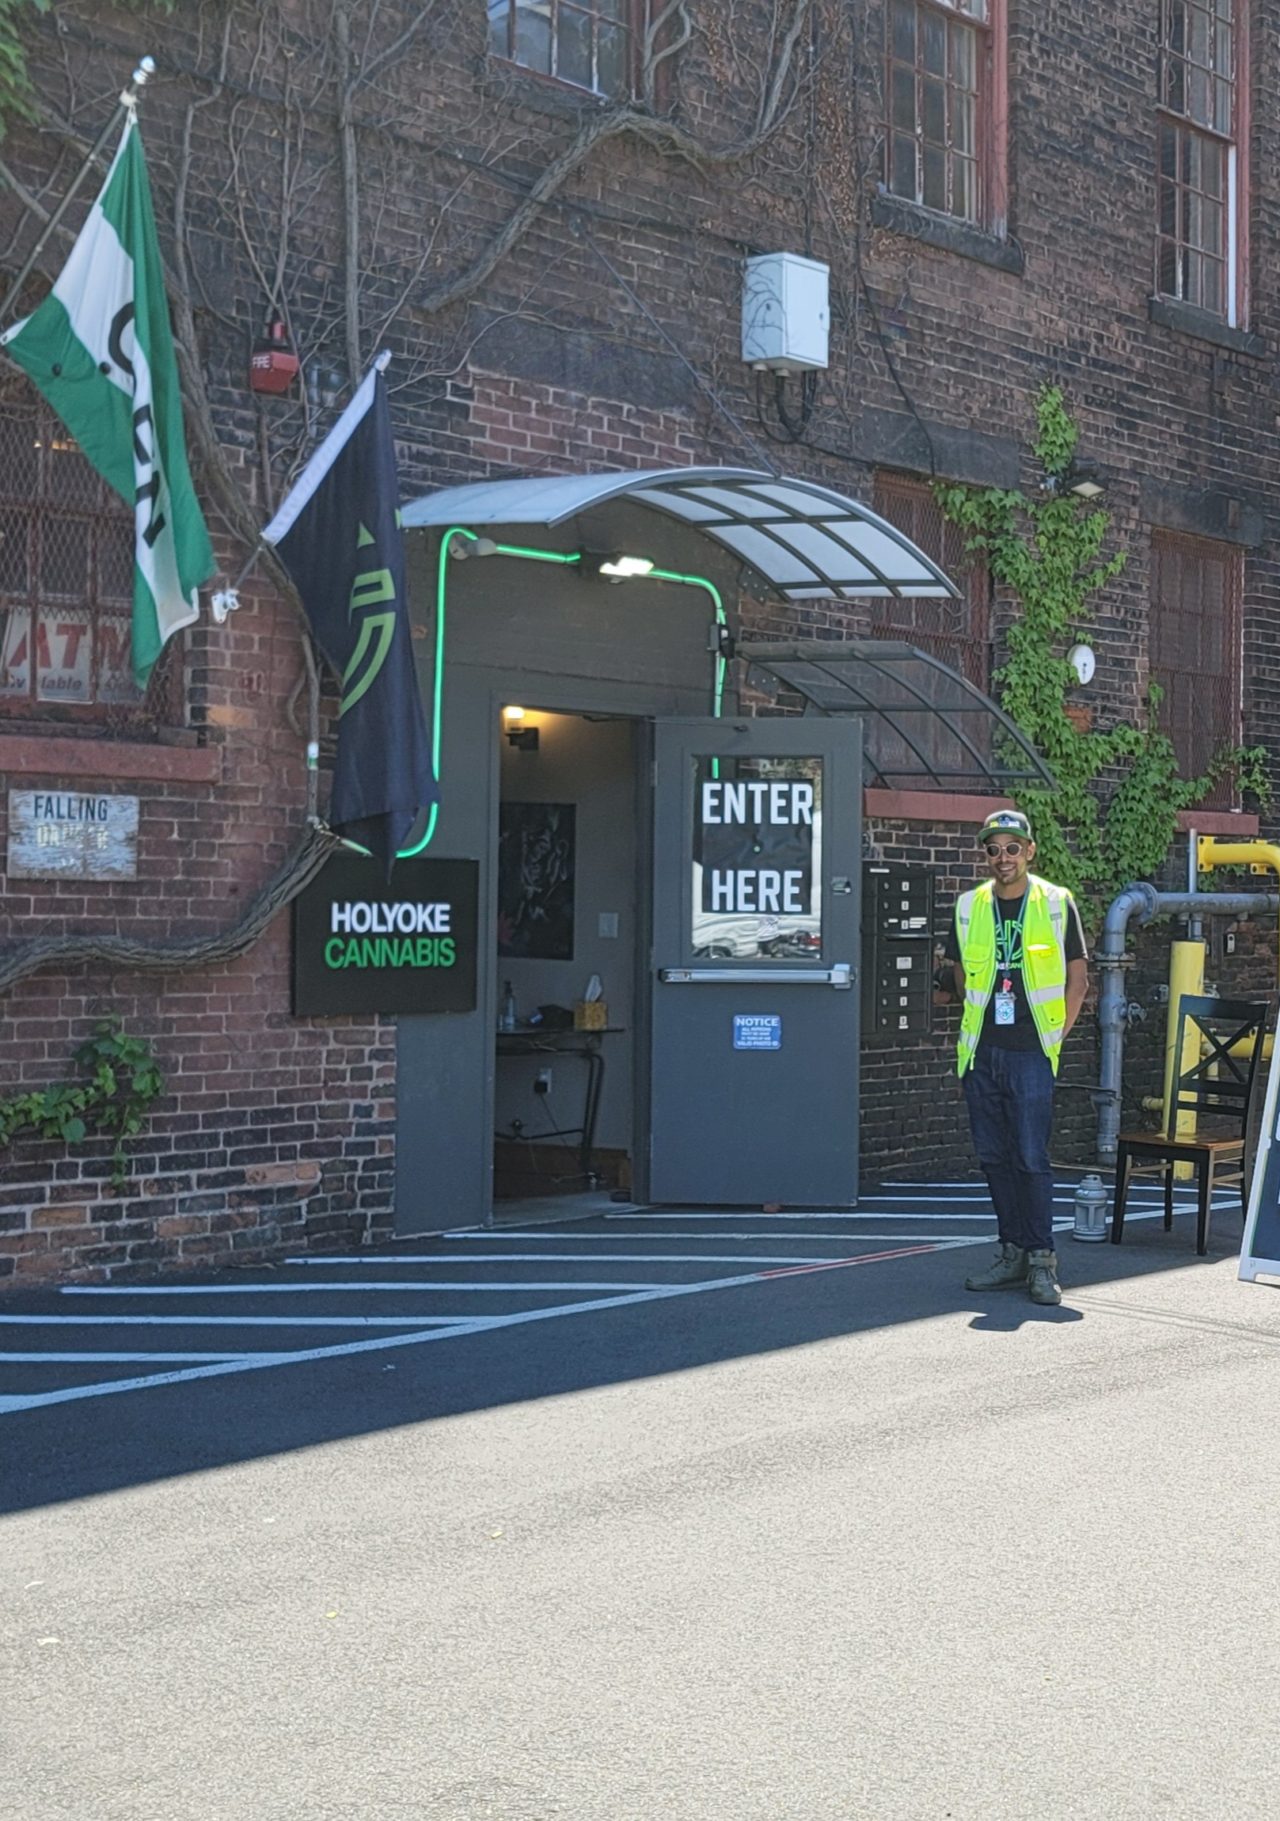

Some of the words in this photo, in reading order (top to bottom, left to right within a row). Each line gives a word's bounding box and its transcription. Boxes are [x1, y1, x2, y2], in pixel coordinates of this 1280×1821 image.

[8, 622, 132, 671] ATM
[33, 794, 108, 821] FALLING
[702, 783, 813, 825] ENTER
[712, 869, 803, 912] HERE
[331, 901, 451, 933] HOLYOKE
[325, 937, 456, 969] CANNABIS
[736, 1017, 778, 1027] NOTICE
